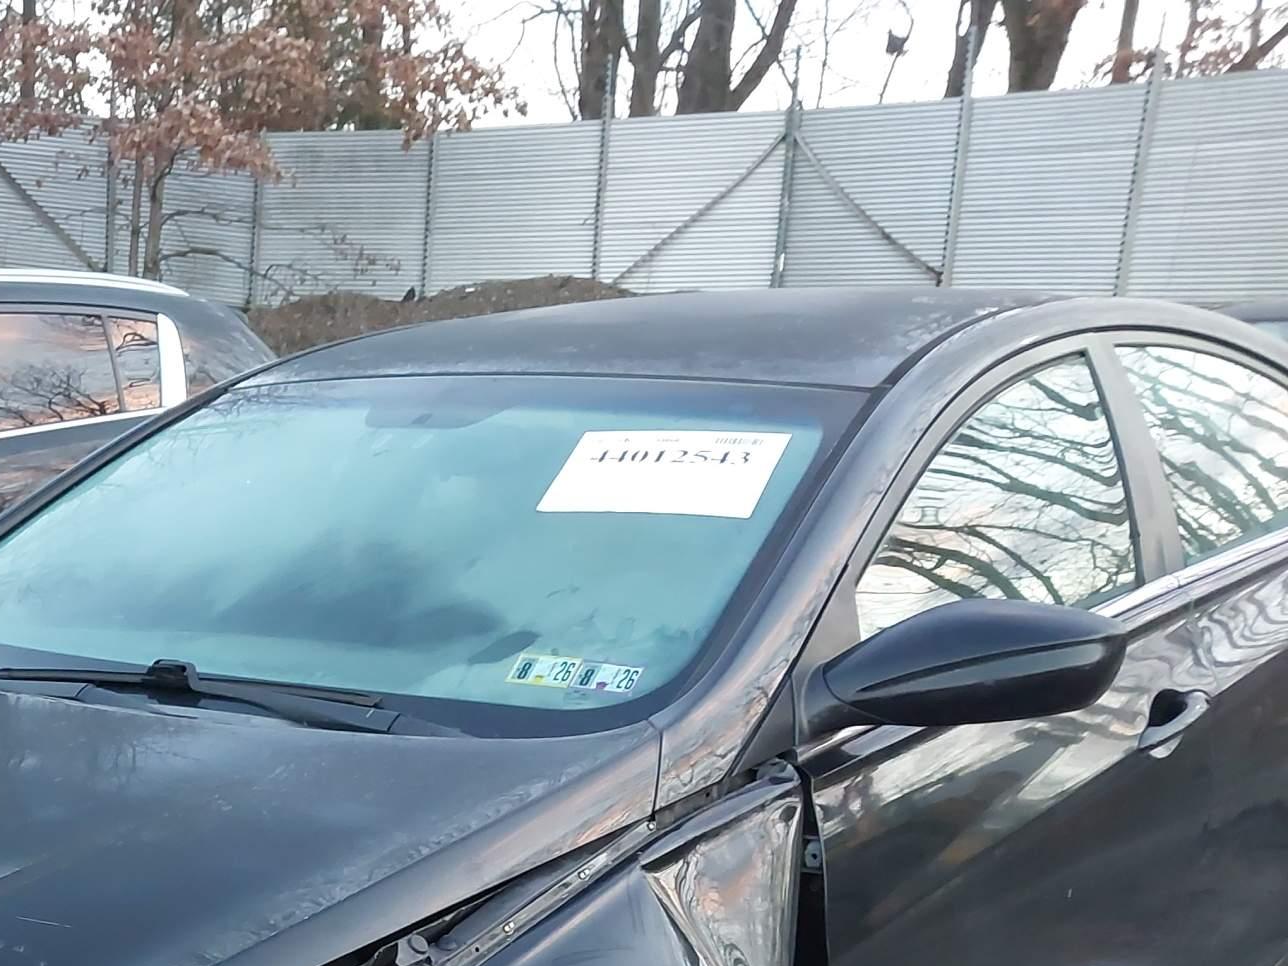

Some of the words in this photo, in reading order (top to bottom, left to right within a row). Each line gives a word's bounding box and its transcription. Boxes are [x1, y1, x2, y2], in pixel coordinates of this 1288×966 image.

[590, 449, 751, 464] 44012543
[517, 661, 532, 680] 8
[553, 661, 577, 682] 26
[579, 668, 595, 687] 8
[616, 668, 640, 690] 26
